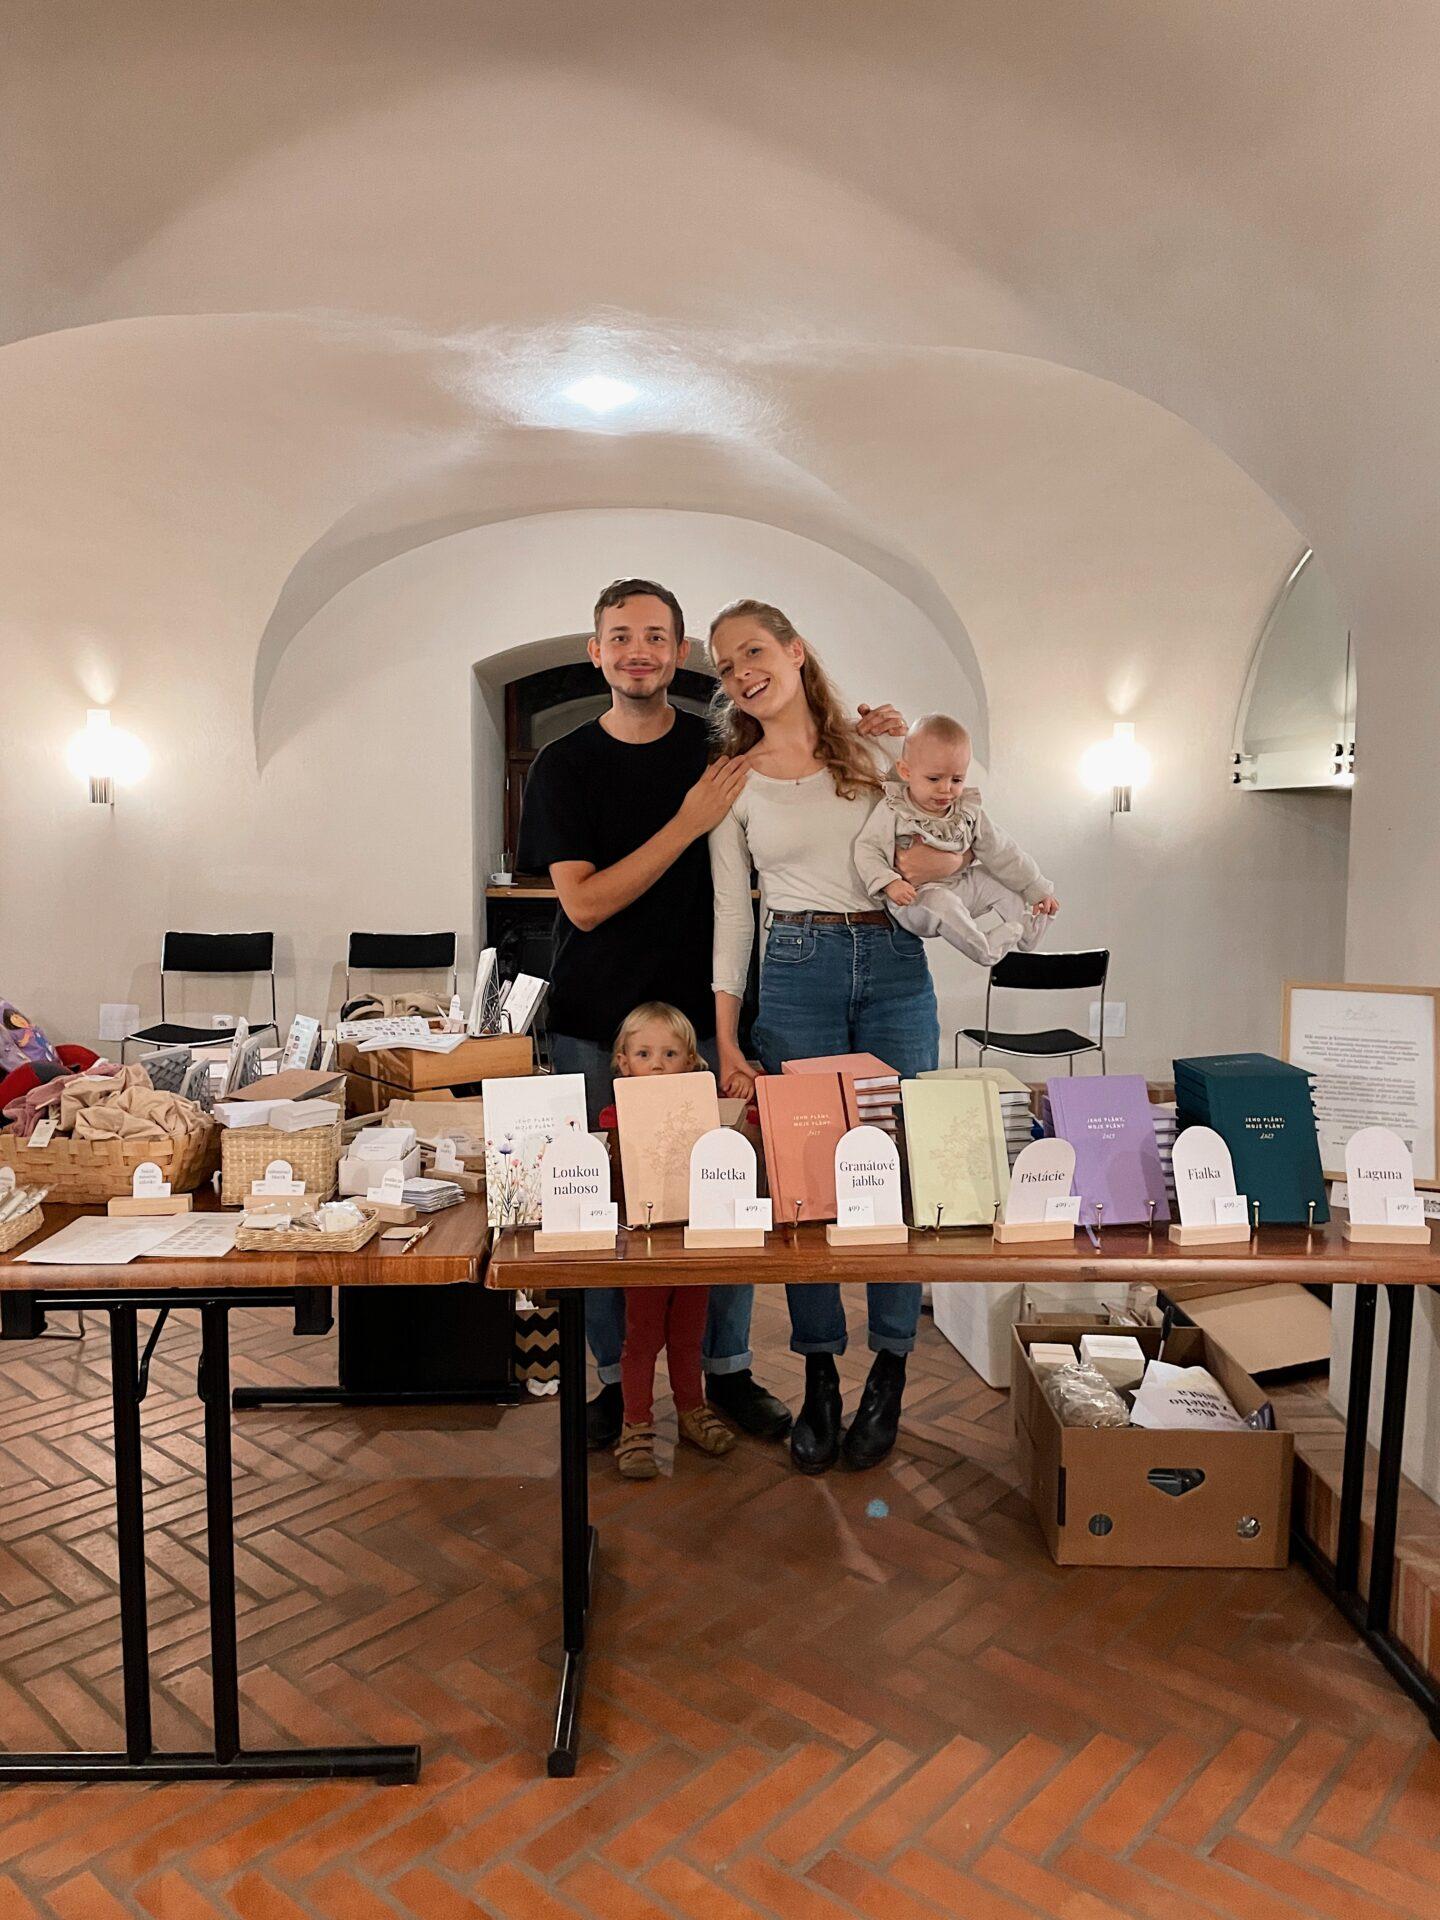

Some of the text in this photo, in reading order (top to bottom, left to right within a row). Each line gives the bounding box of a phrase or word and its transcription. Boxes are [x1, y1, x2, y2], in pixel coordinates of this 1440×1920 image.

[839, 1156, 895, 1172] Granátové
[552, 1165, 600, 1179] Loukou
[701, 1167, 746, 1181] Baletka
[1020, 1170, 1065, 1184] Pistácie
[1187, 1166, 1221, 1181] Fialka
[1357, 1166, 1403, 1182] Laguna
[553, 1182, 599, 1195] naboso
[852, 1175, 885, 1188] jablko
